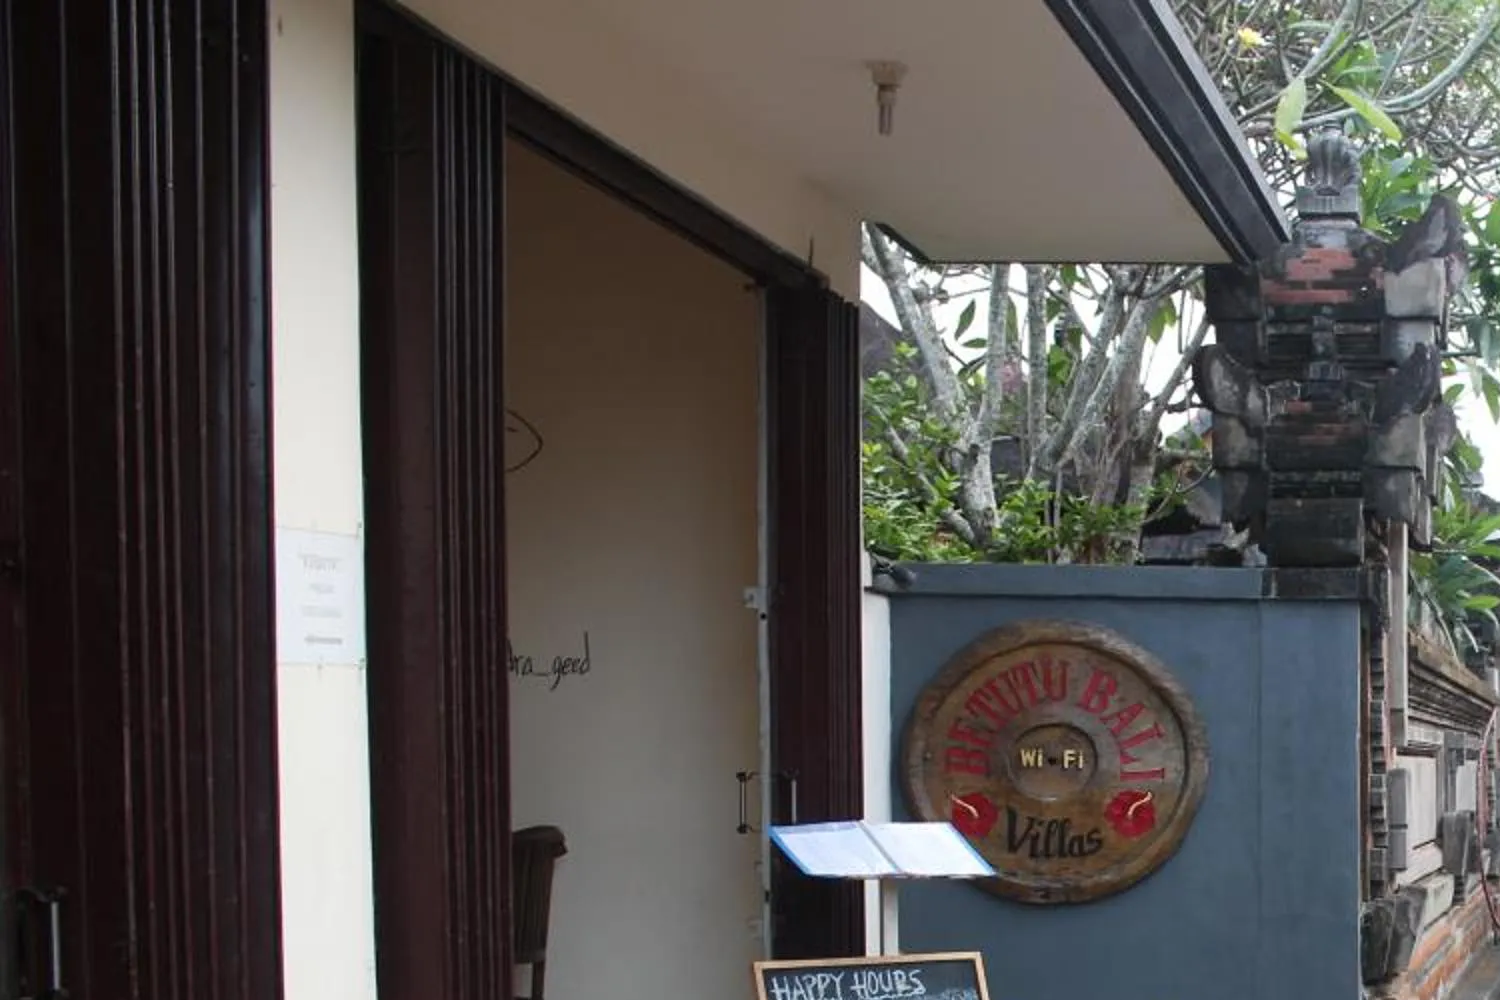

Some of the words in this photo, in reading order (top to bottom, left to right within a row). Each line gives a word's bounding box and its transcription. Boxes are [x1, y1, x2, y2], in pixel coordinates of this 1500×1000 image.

[1077, 667, 1167, 781] BALI
[1005, 805, 1103, 859] Villas
[850, 969, 927, 1000] HOURS
